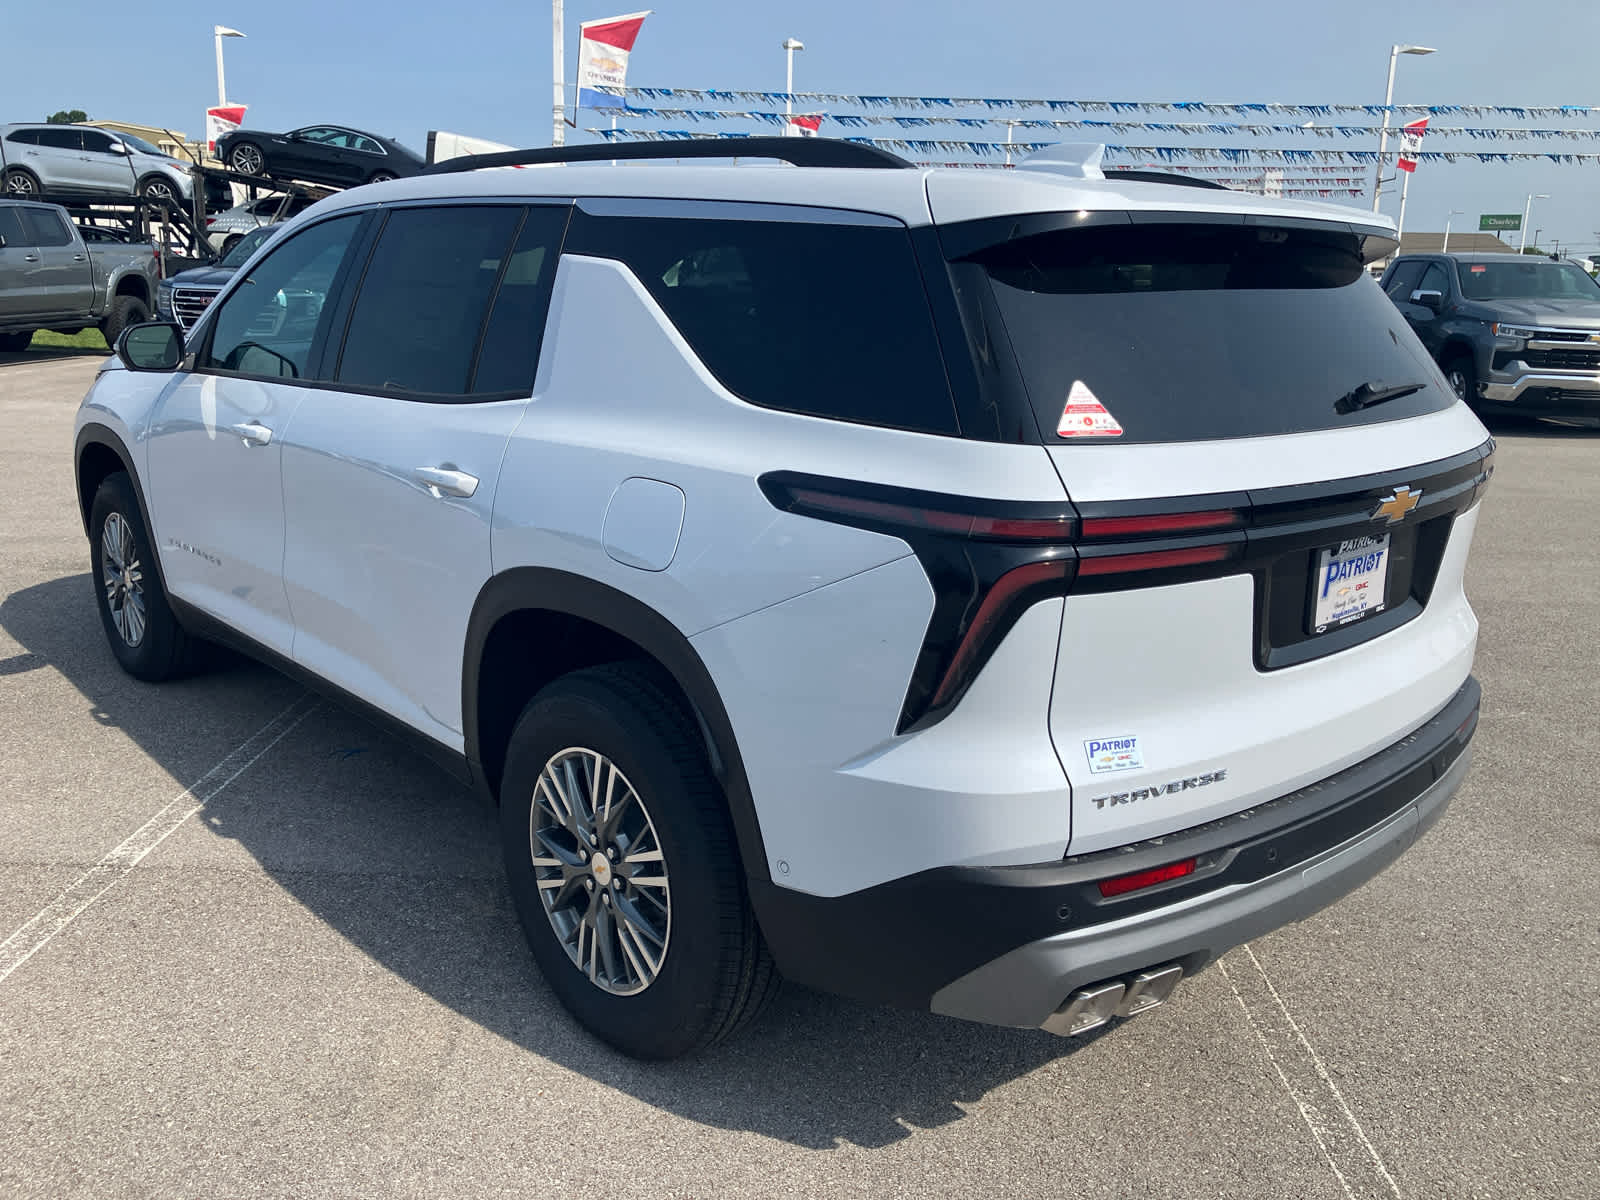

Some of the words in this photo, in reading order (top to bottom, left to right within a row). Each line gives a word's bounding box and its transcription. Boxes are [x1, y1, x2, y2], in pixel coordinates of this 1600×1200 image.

[1322, 552, 1383, 598] PATRIOT
[1089, 738, 1137, 759] PATRIOT
[1091, 769, 1228, 810] TRAVERSE
